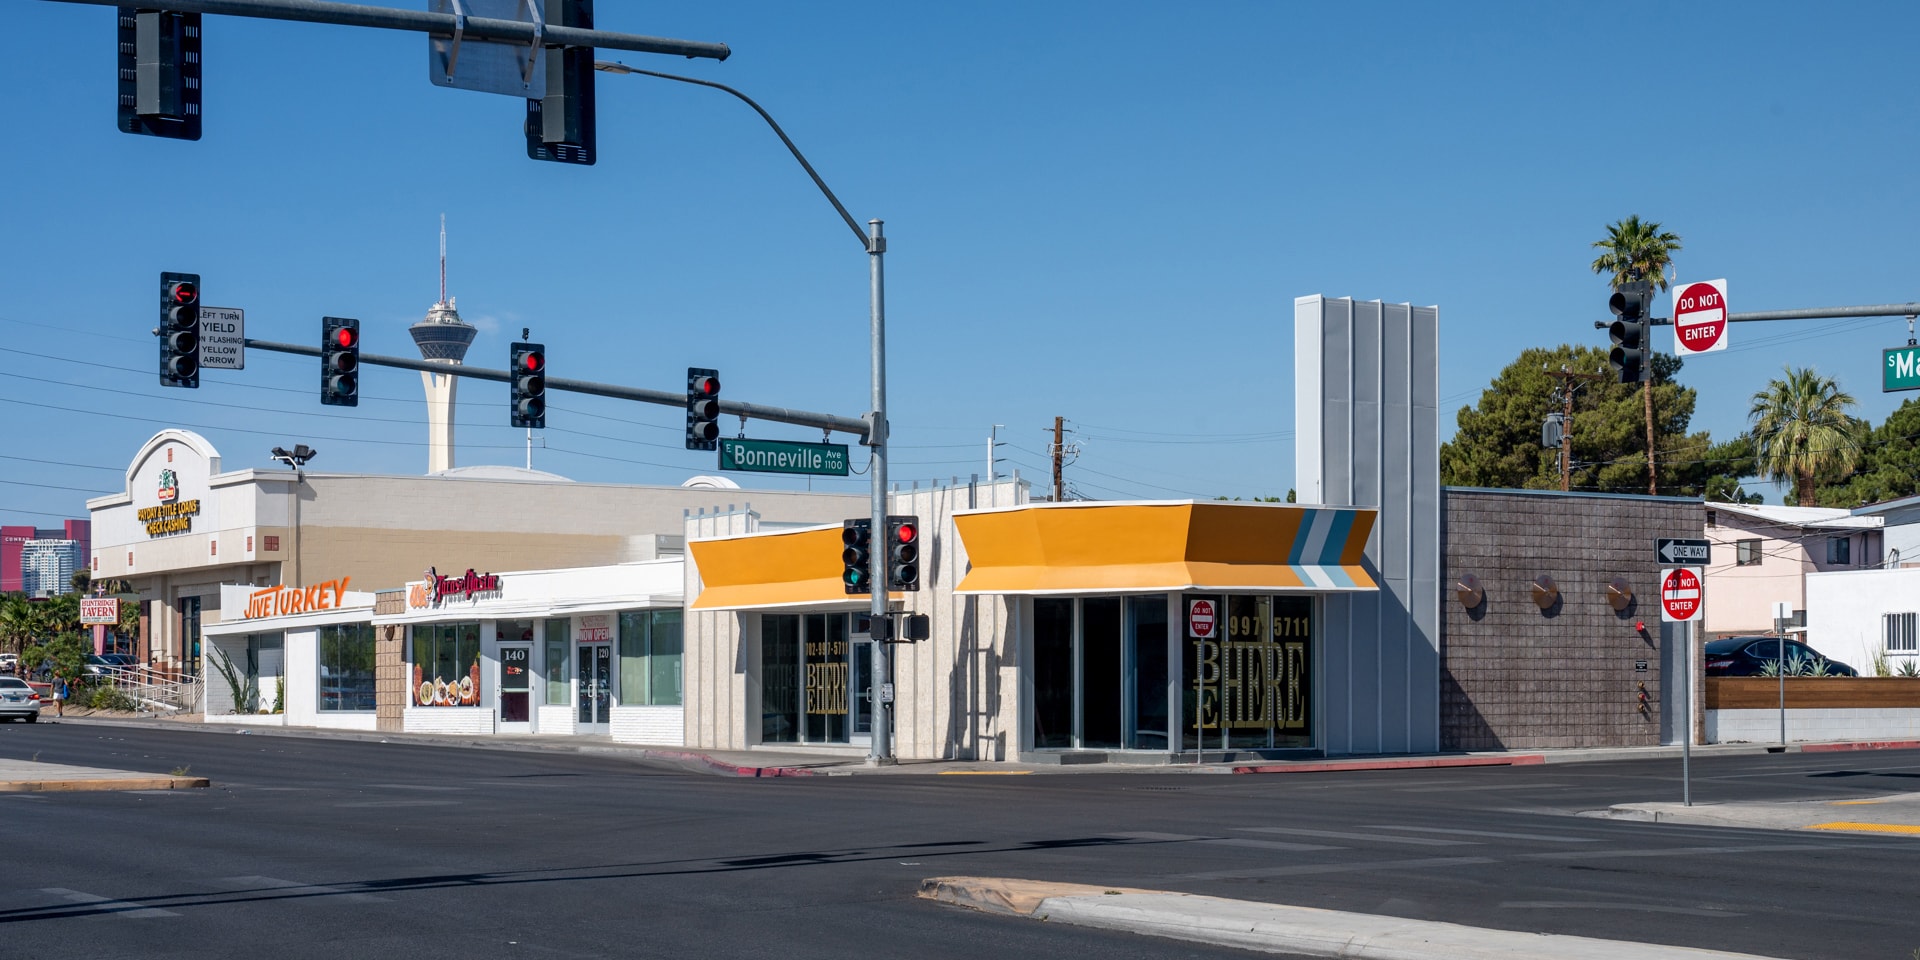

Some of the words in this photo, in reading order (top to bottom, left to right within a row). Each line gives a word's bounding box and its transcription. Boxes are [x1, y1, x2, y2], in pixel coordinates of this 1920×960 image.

[1681, 297, 1694, 310] DO
[1699, 293, 1719, 307] NOT
[220, 312, 240, 320] TURN
[202, 322, 236, 333] YIELD
[1685, 326, 1716, 341] ENTER
[209, 336, 242, 345] FLASHING
[202, 346, 237, 354] YELLOW
[203, 356, 235, 364] ARROW
[1888, 355, 1895, 367] S
[726, 444, 732, 453] E
[734, 444, 822, 469] Bonneville
[826, 450, 841, 459] Ave
[824, 460, 843, 470] 1100
[138, 506, 157, 521] PAYDAY
[162, 503, 177, 517] TITLE
[178, 500, 197, 514] LOANS
[146, 521, 163, 535] CHECK
[164, 517, 188, 533] CASHING
[1673, 546, 1688, 557] ONE
[1690, 546, 1705, 557] WAY
[1667, 579, 1678, 588] DO
[1681, 578, 1695, 587] NOT
[254, 575, 351, 616] TURKEY
[1670, 601, 1693, 611] ENTER
[82, 607, 115, 617] TAVERN
[580, 629, 593, 640] NOW
[594, 628, 609, 640] OPEN
[505, 650, 525, 660] 140
[598, 648, 609, 658] 120
